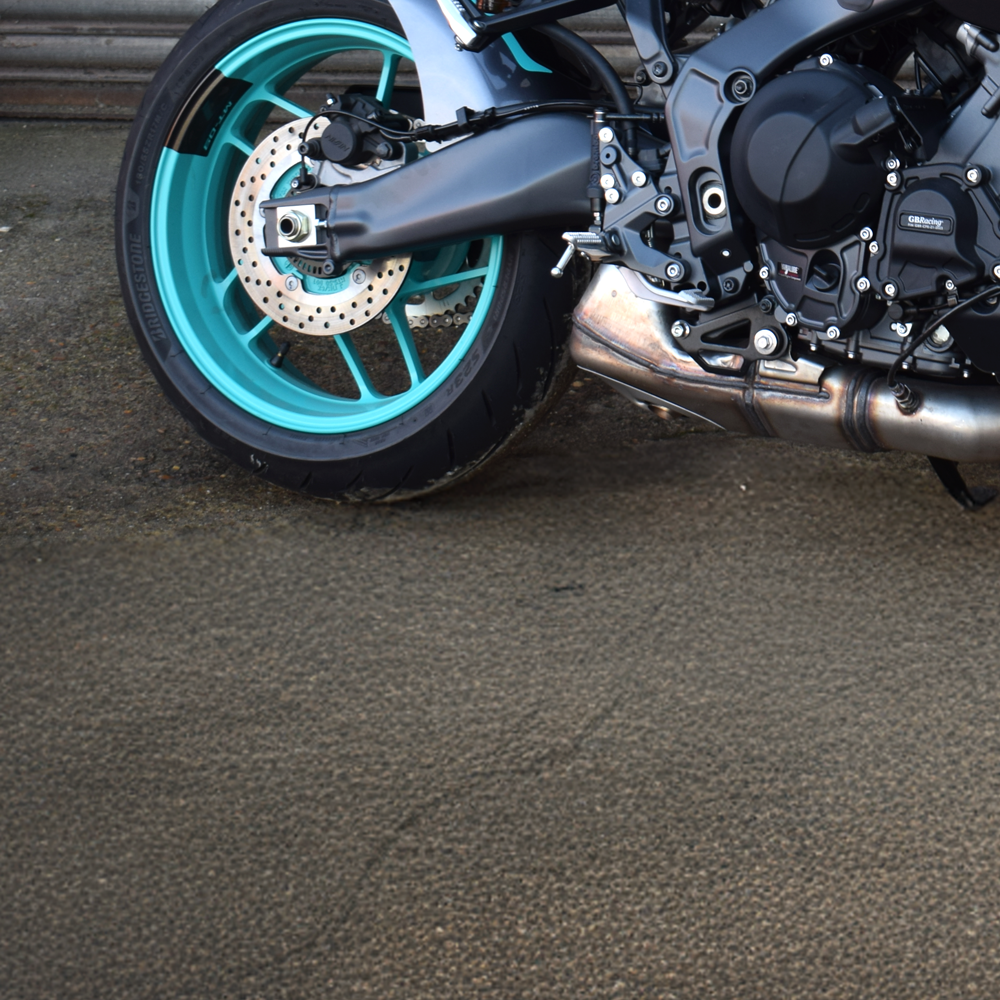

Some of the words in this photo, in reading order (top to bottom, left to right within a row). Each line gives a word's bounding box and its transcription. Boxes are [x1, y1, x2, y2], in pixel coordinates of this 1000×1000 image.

[202, 100, 233, 151] MT-09
[130, 233, 168, 341] BRIDGESTONE
[446, 348, 480, 397] S23R
